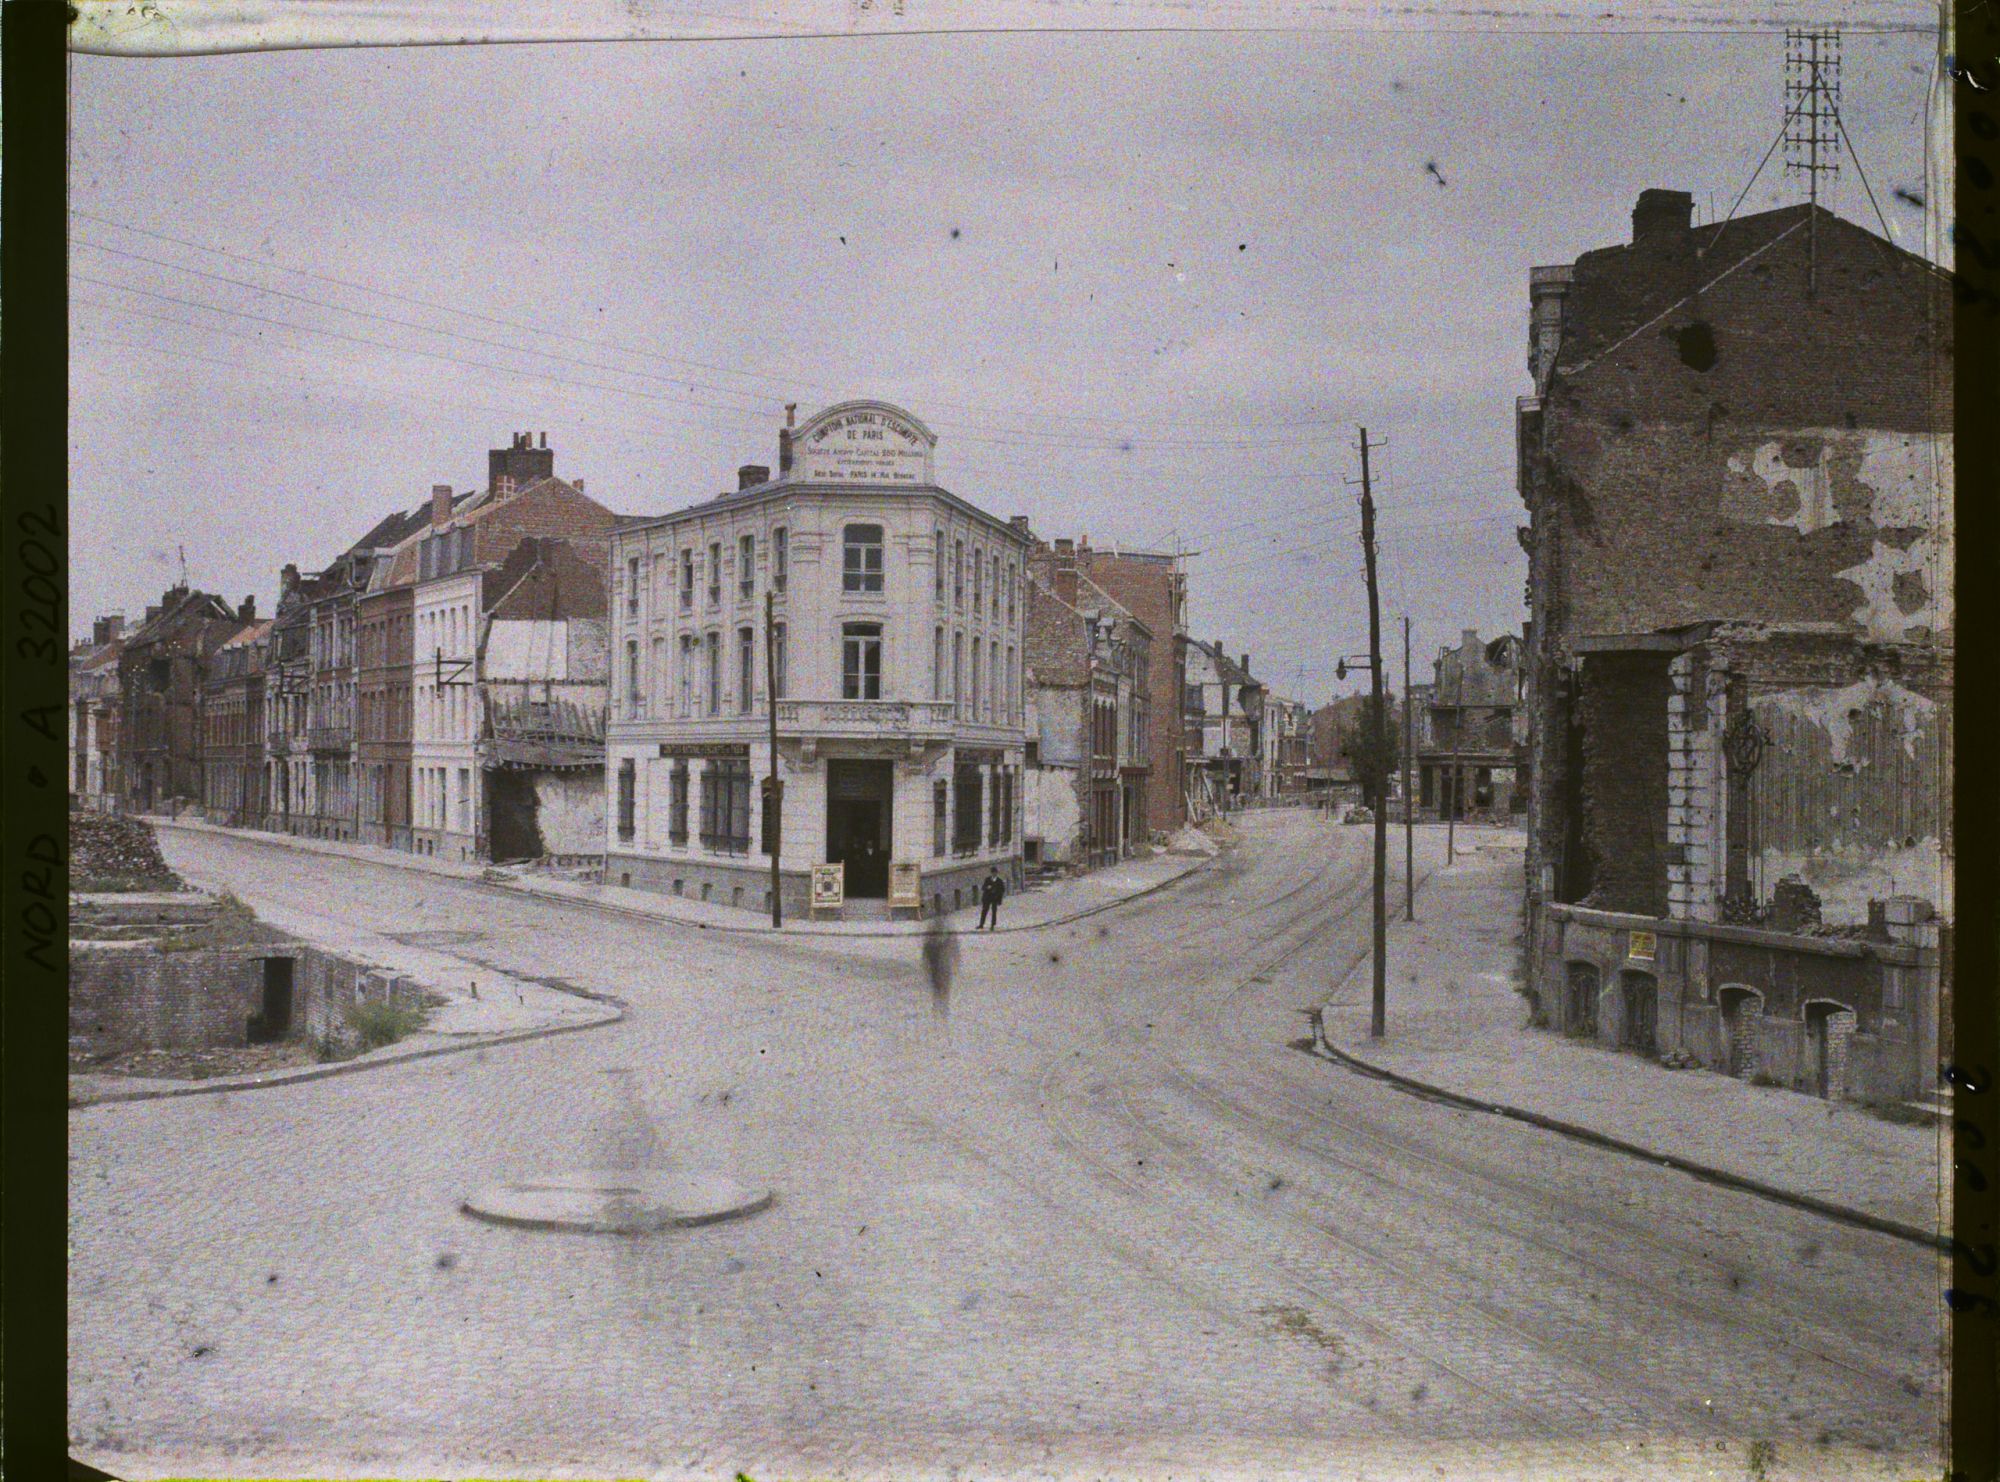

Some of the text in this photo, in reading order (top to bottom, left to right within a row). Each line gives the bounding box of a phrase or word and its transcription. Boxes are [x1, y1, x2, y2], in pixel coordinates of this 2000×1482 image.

[845, 413, 876, 426] NATIONAL
[847, 430, 884, 441] DE PARIS
[16, 503, 66, 973] NORD A 32002
